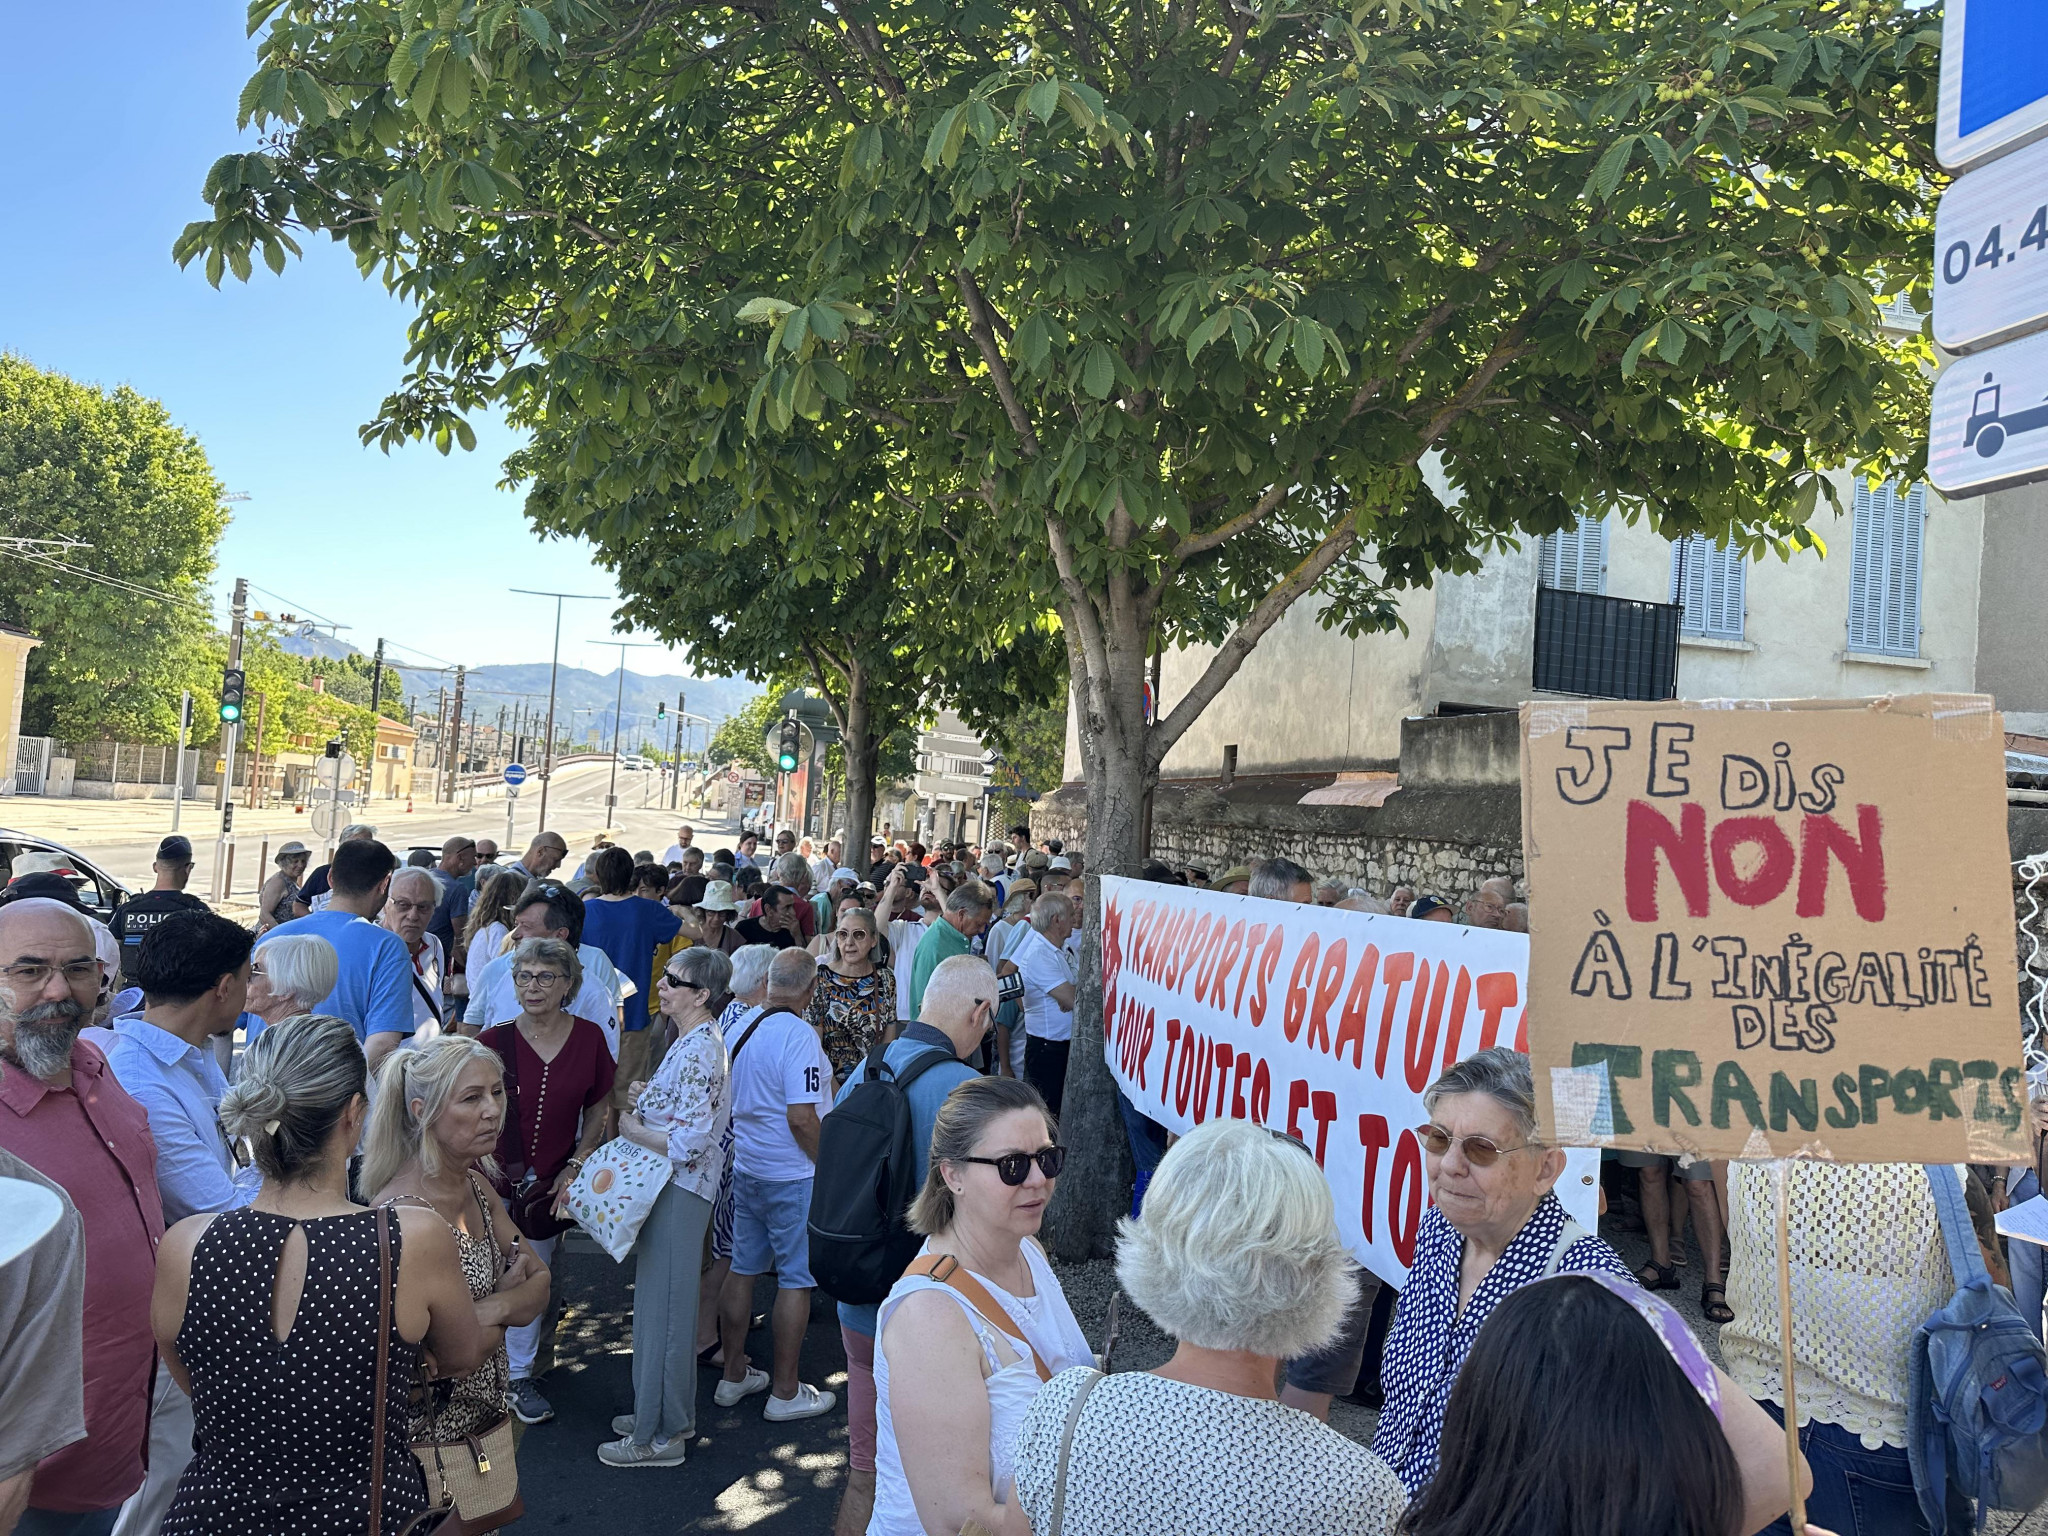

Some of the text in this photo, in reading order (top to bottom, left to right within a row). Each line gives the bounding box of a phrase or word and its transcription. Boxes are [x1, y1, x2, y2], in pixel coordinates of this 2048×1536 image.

[1943, 204, 2048, 284] 04.4
[1556, 722, 1694, 805] JE
[1624, 799, 1887, 922] NON
[1125, 899, 1284, 1027] TRANSPORTS
[1570, 909, 1632, 1000] À
[1731, 1002, 1838, 1053] DES
[803, 1066, 820, 1093] 15
[1571, 1042, 2023, 1137] TRANSPORTS
[1115, 992, 1154, 1091] POUR
[1286, 1079, 1337, 1173] ET
[1359, 1113, 1435, 1269] TO
